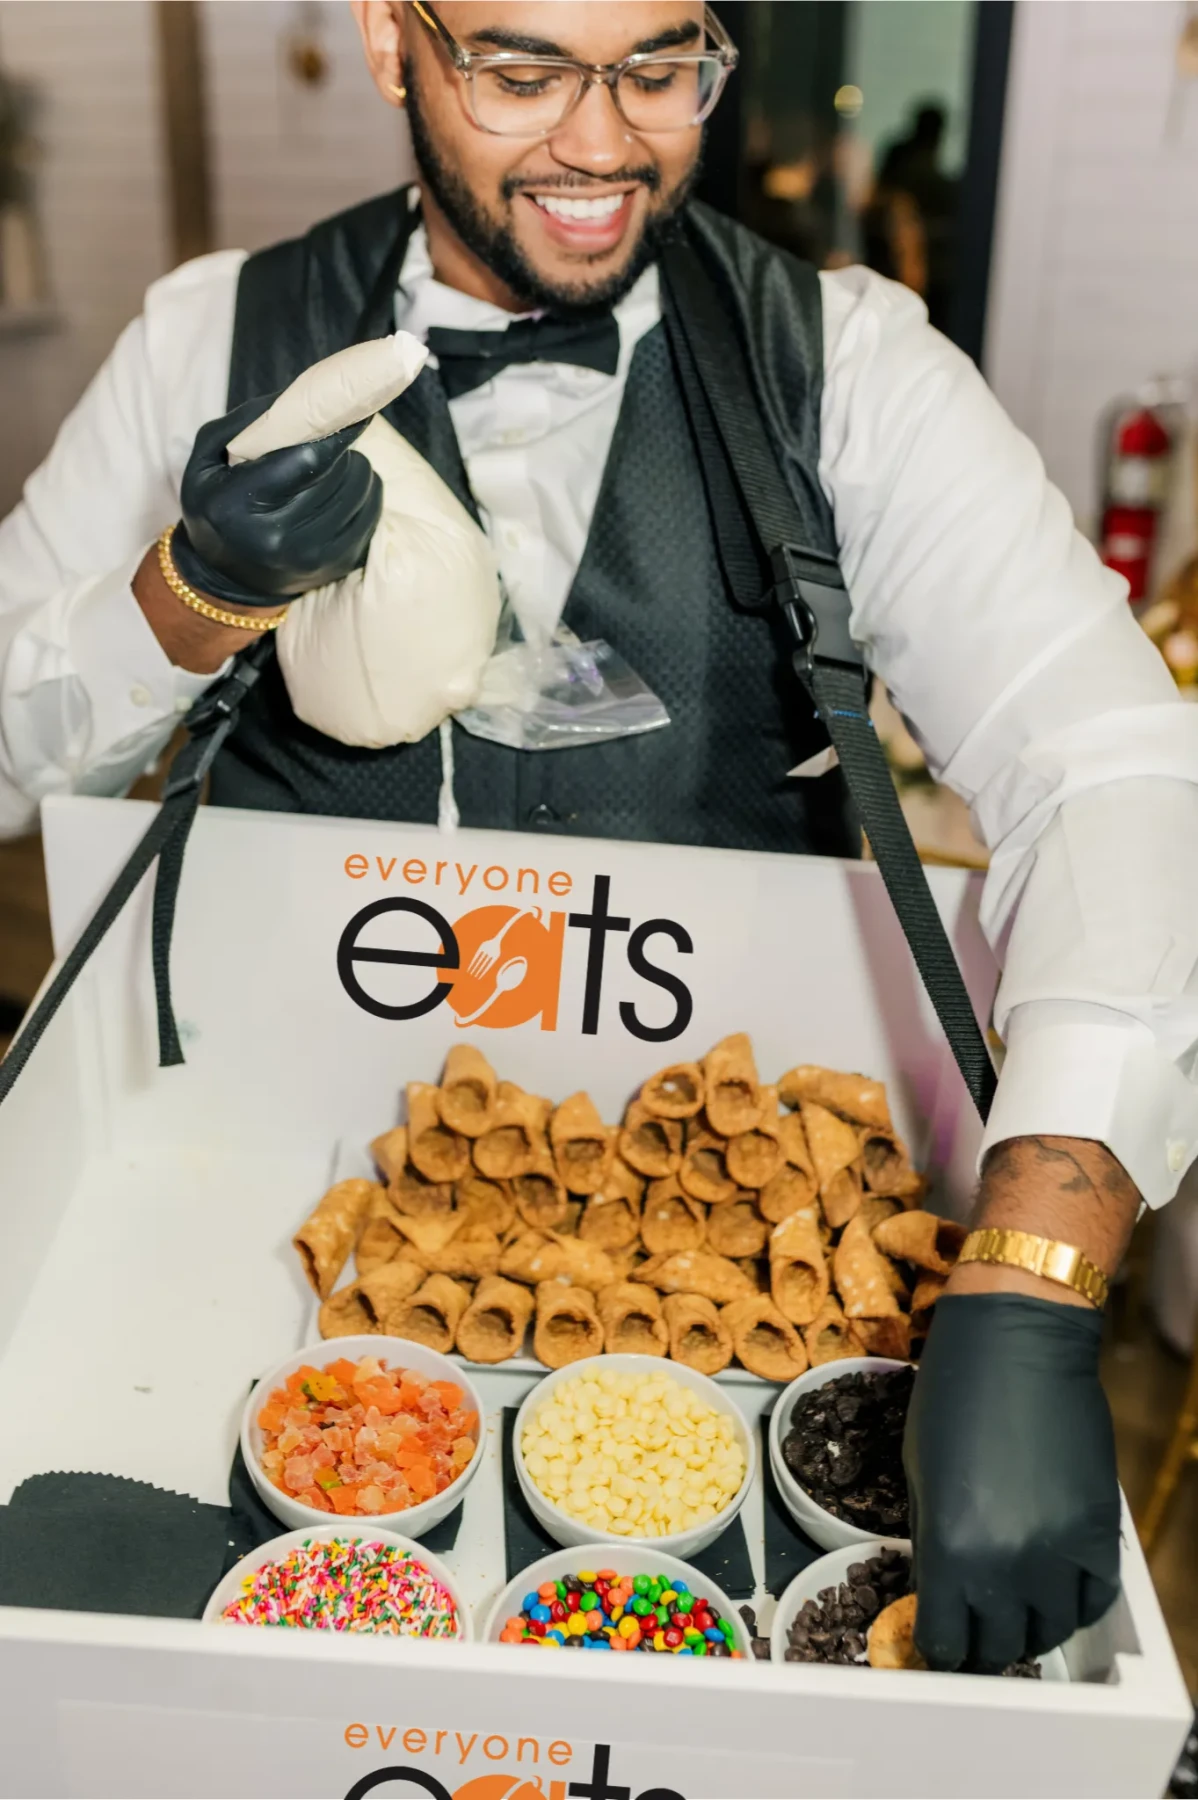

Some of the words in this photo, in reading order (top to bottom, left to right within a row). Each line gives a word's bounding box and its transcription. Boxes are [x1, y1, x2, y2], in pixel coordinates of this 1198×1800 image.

[344, 853, 573, 897] everyone
[337, 874, 694, 1043] eats
[344, 1722, 573, 1766] everyone
